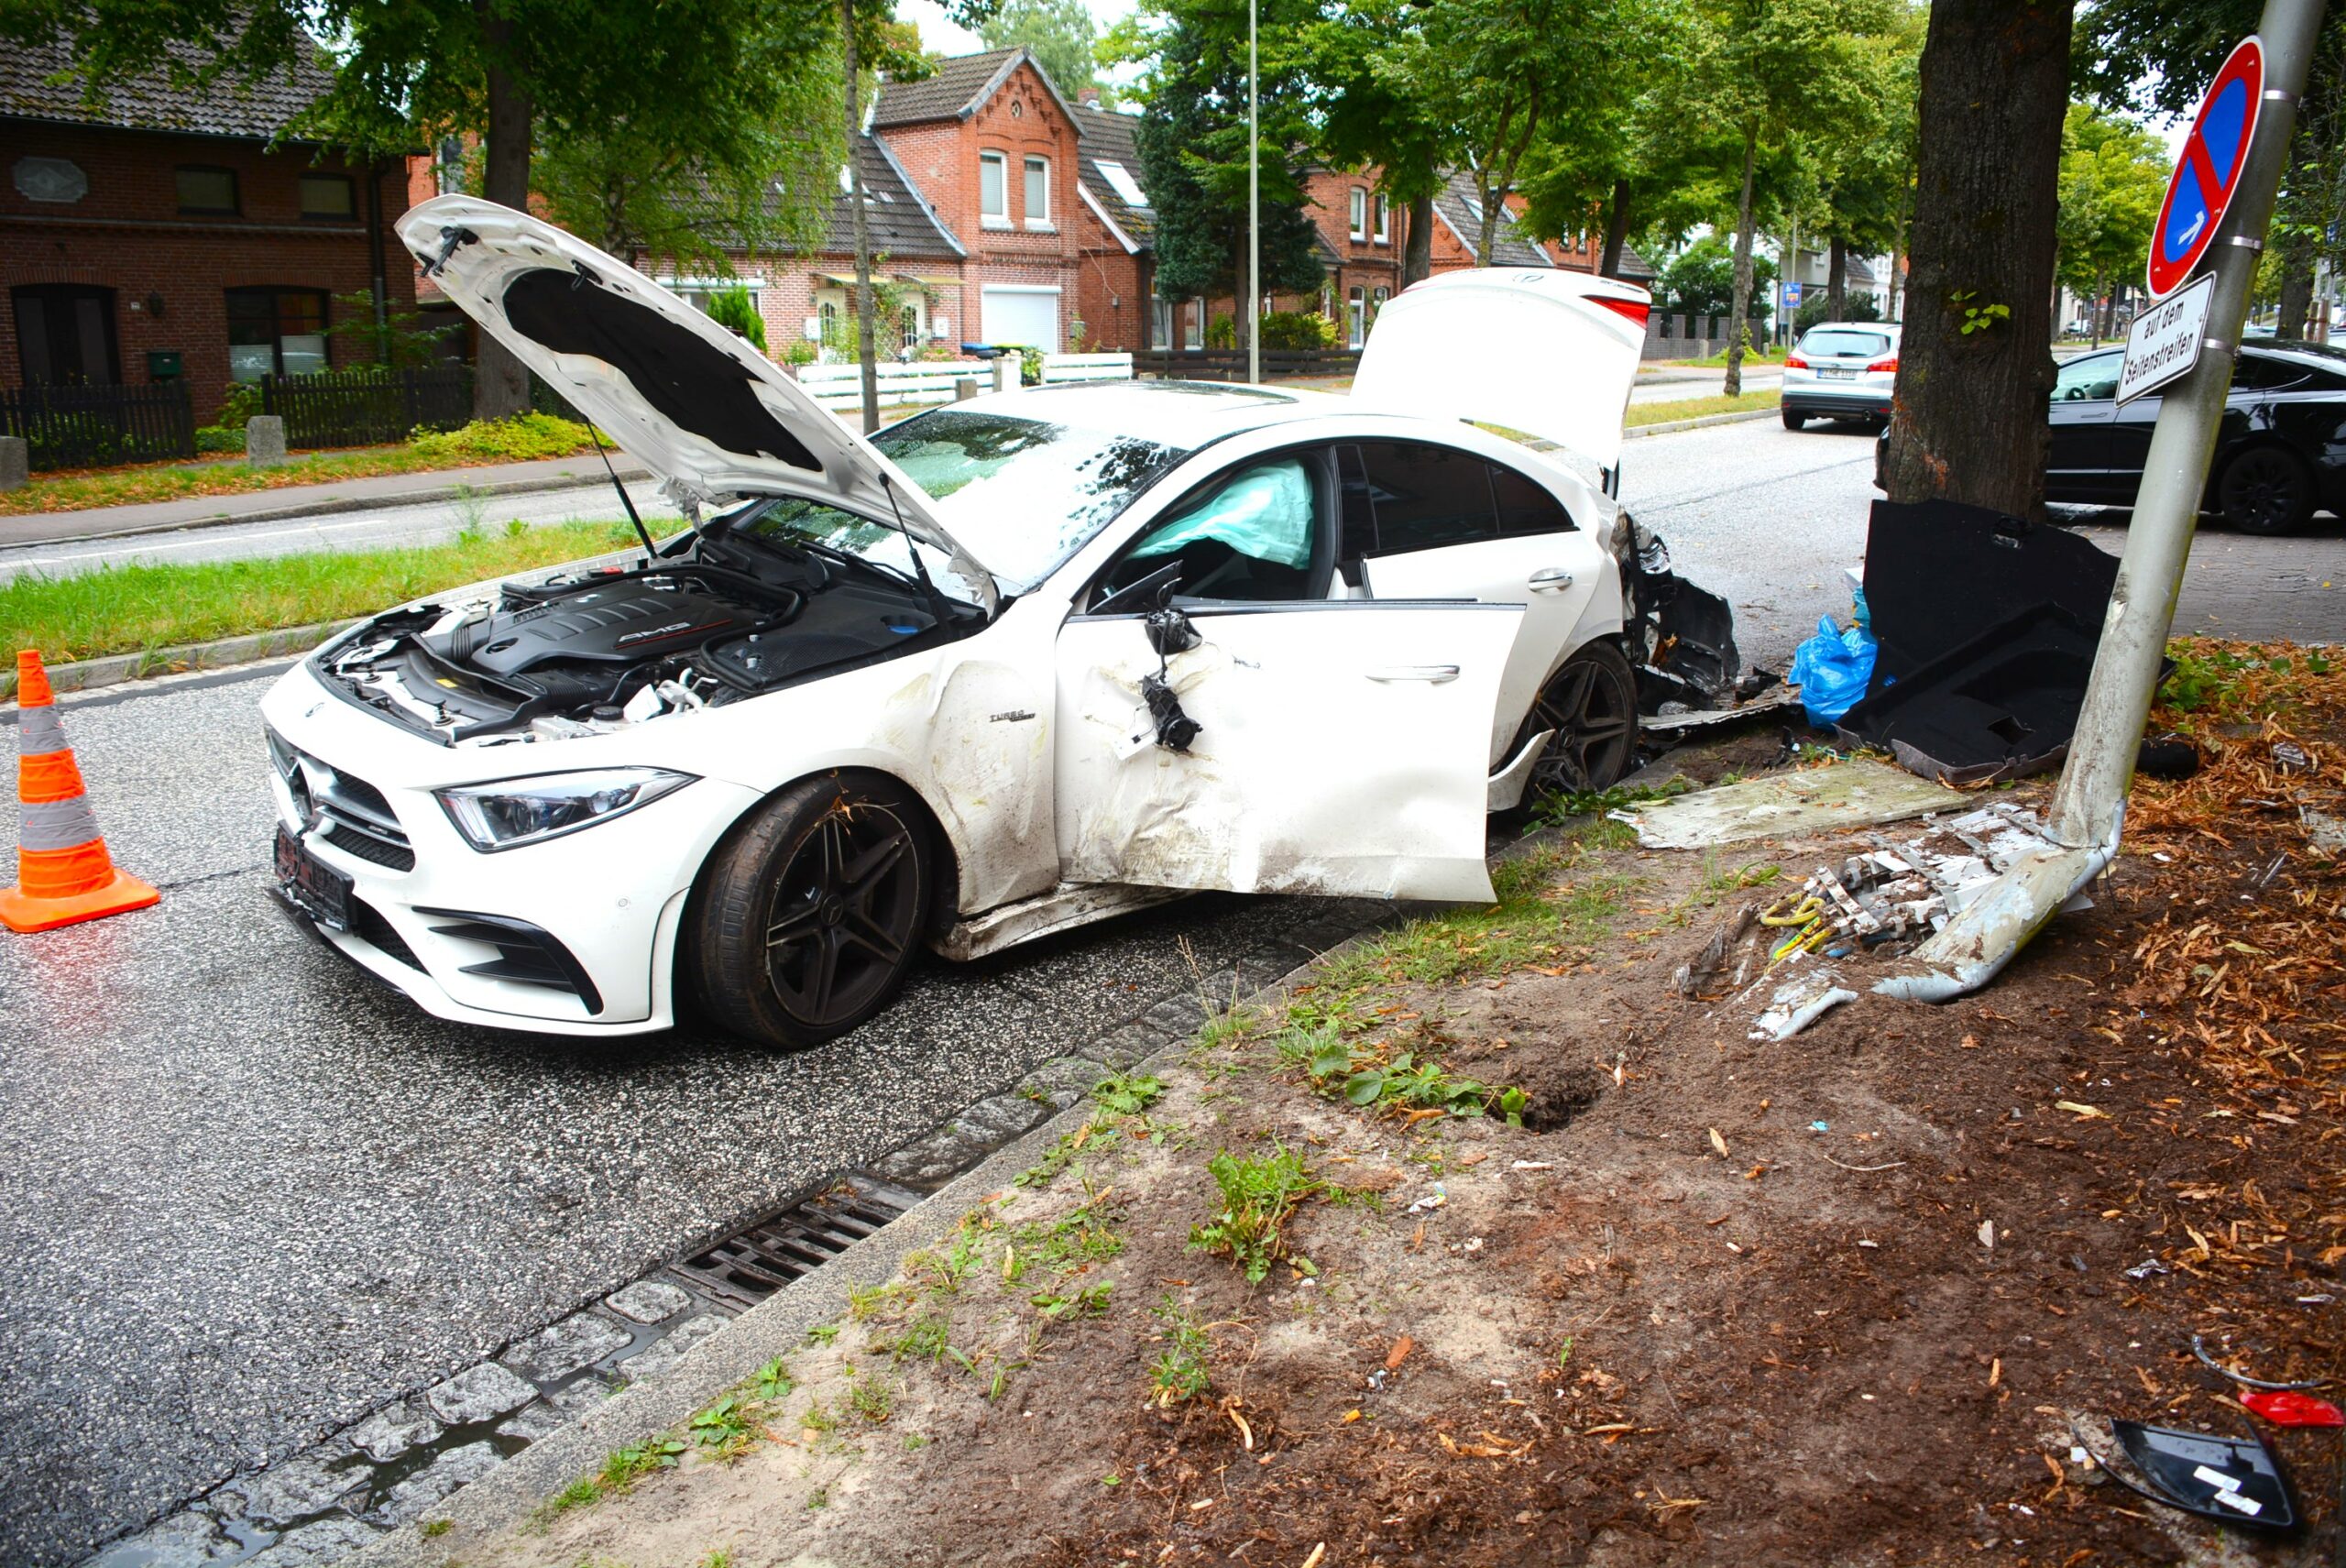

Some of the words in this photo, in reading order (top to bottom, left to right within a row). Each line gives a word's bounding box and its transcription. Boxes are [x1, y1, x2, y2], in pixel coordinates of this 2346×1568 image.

[2144, 308, 2163, 340] auf
[2162, 301, 2185, 330] dem
[2125, 331, 2194, 385] Seitenstreifen
[619, 622, 691, 642] AMG
[990, 709, 1025, 723] TURBO
